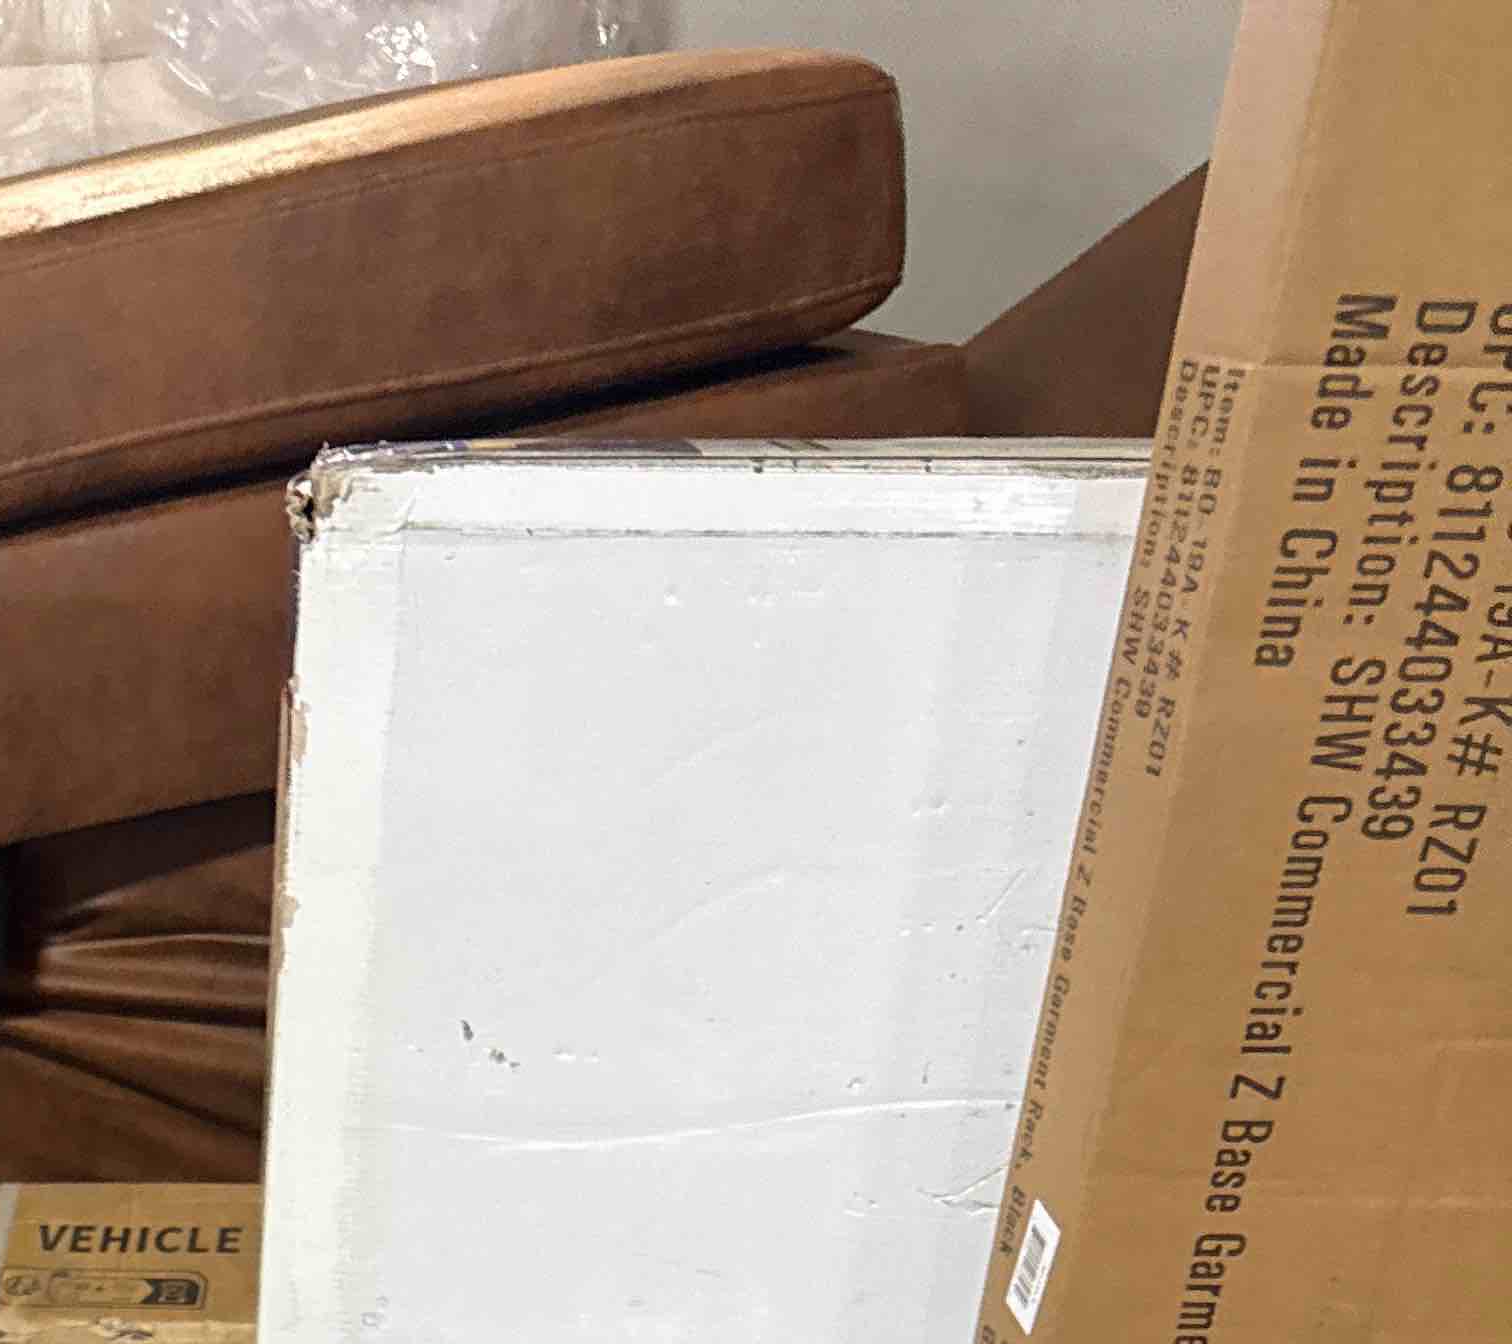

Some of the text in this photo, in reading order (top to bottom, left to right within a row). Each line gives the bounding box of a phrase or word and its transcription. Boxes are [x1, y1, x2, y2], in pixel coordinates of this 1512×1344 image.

[1254, 294, 1398, 668] Made in China
[1343, 301, 1479, 624] Description:
[1361, 464, 1504, 840] 811244033439
[1310, 656, 1387, 771] SHW
[1406, 804, 1487, 915] RZ01
[1241, 796, 1354, 1055] Commercial
[1229, 1074, 1285, 1100] Z
[1205, 1120, 1274, 1213] Base
[39, 1225, 244, 1254] VEHICLE
